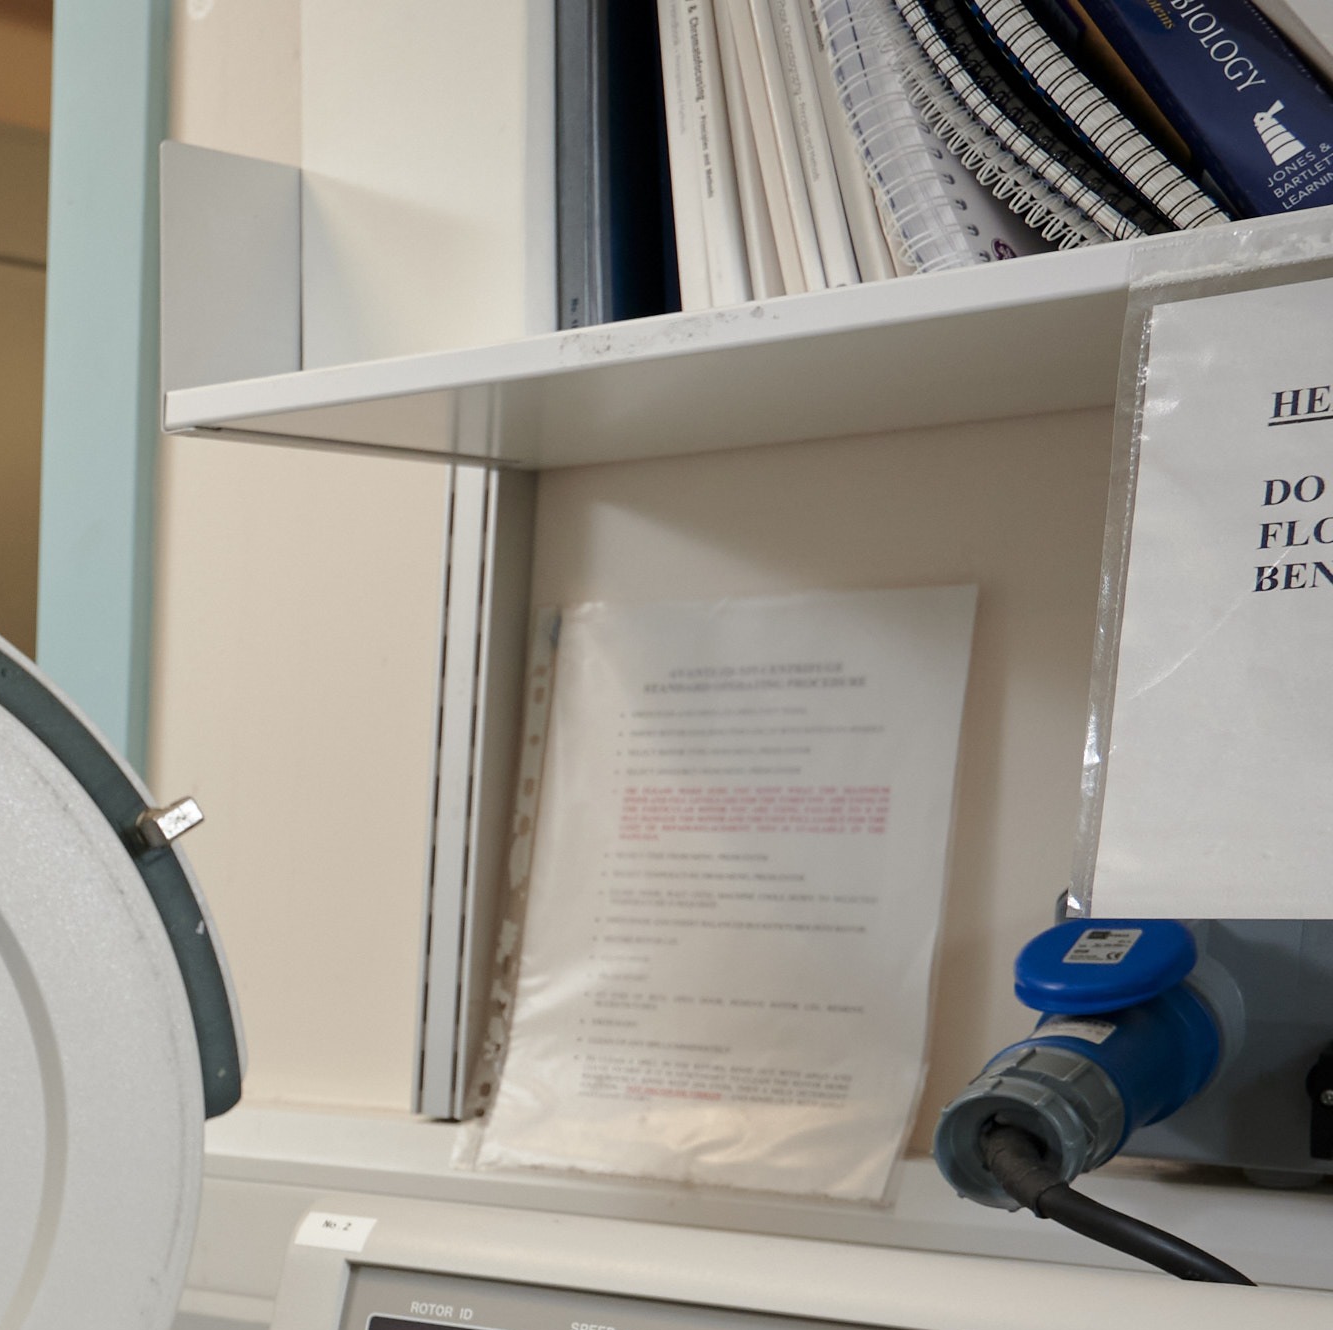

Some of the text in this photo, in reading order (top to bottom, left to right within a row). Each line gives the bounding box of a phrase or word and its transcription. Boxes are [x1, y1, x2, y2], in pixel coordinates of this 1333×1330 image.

[1267, 150, 1316, 188] JONES
[1273, 152, 1333, 198] BARTLET
[1270, 385, 1333, 419] HE
[1261, 475, 1325, 507] DO
[410, 1301, 474, 1321] ROTOR ID
